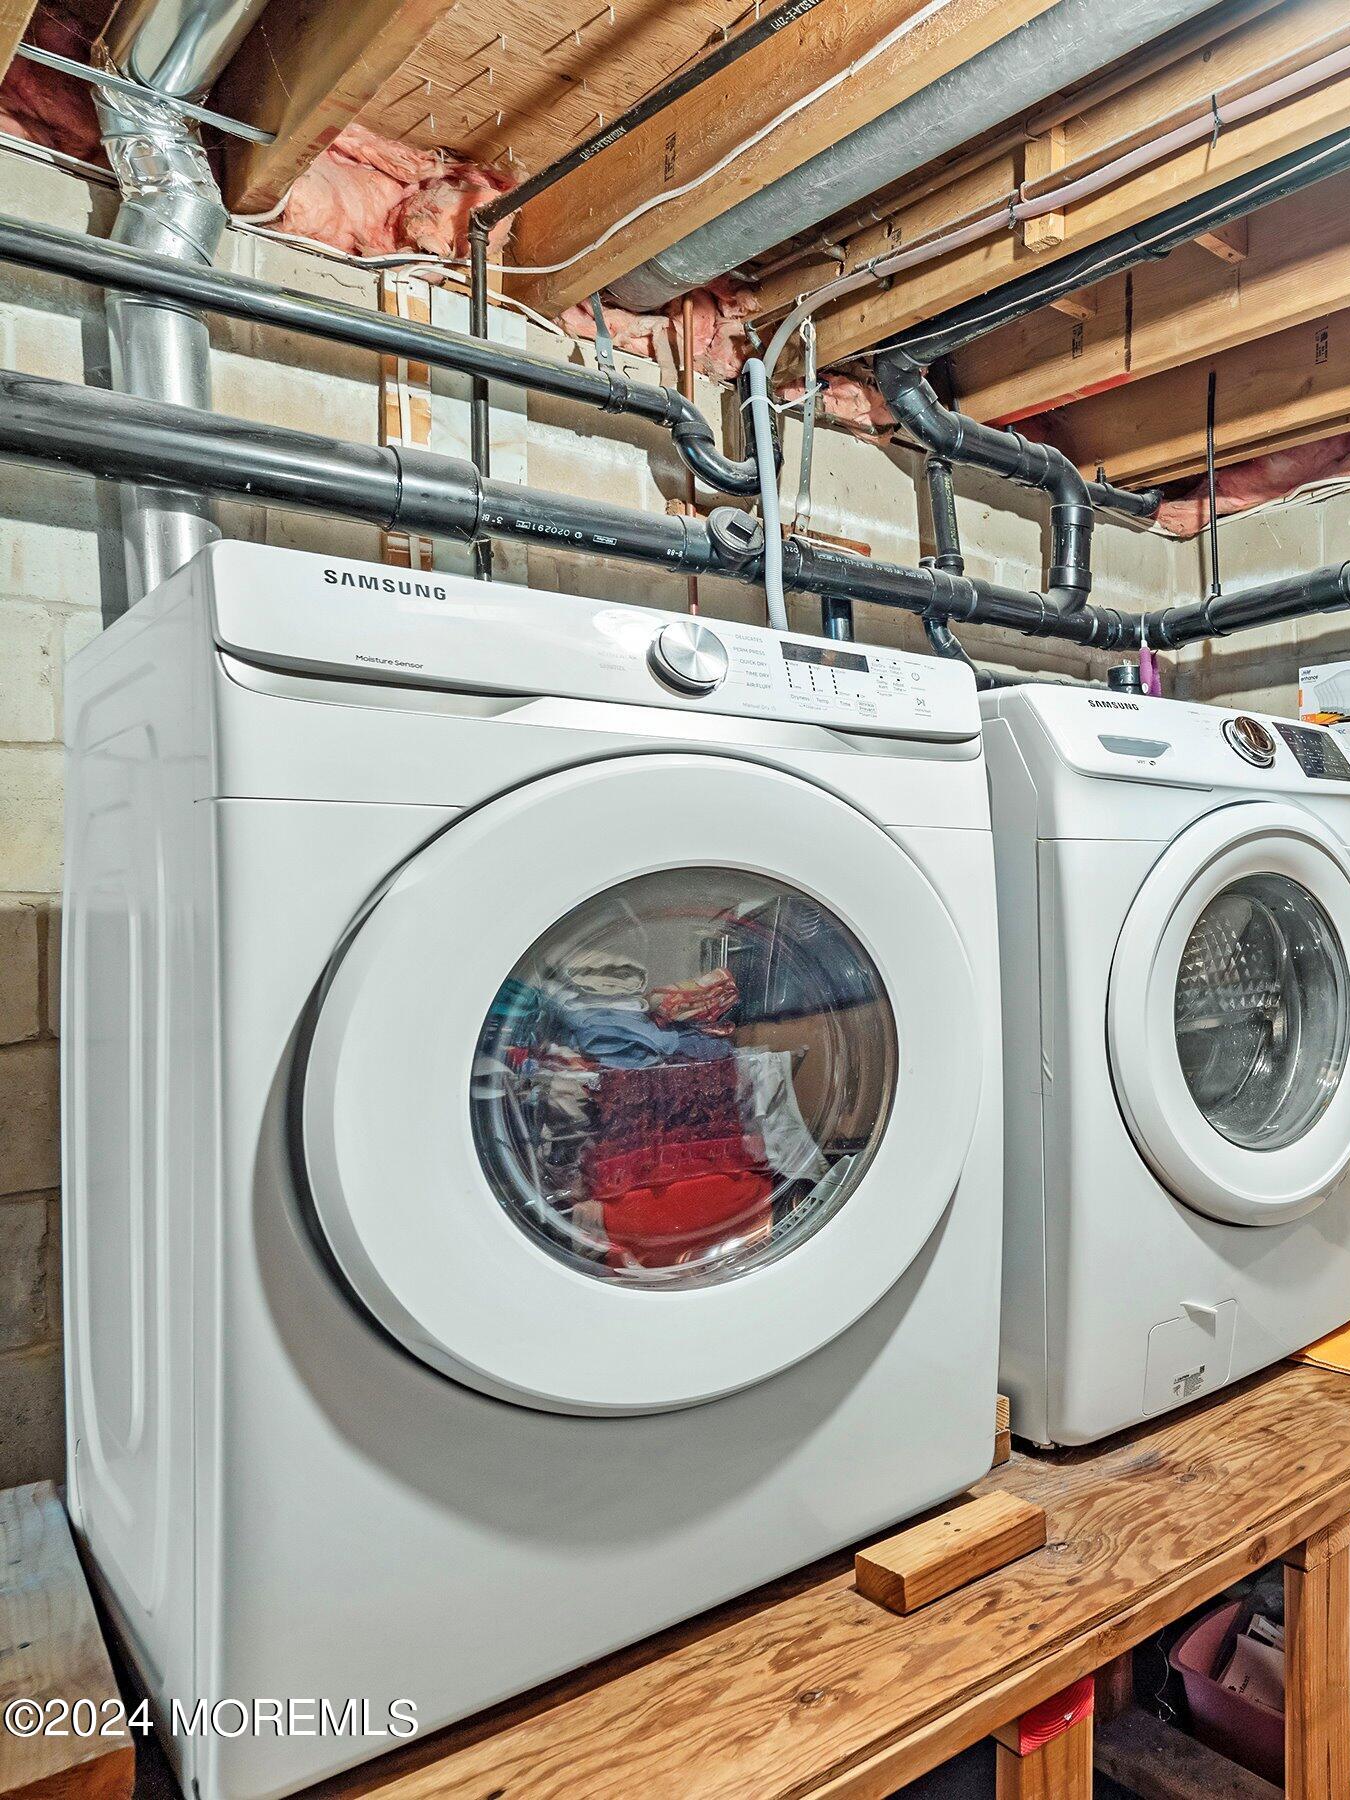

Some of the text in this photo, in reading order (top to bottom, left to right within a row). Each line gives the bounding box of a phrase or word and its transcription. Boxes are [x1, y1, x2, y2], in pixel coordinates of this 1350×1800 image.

[323, 569, 447, 601] SAMSUNG
[355, 654, 424, 669] Moisture Sensor
[1088, 699, 1140, 711] SAMSUNG
